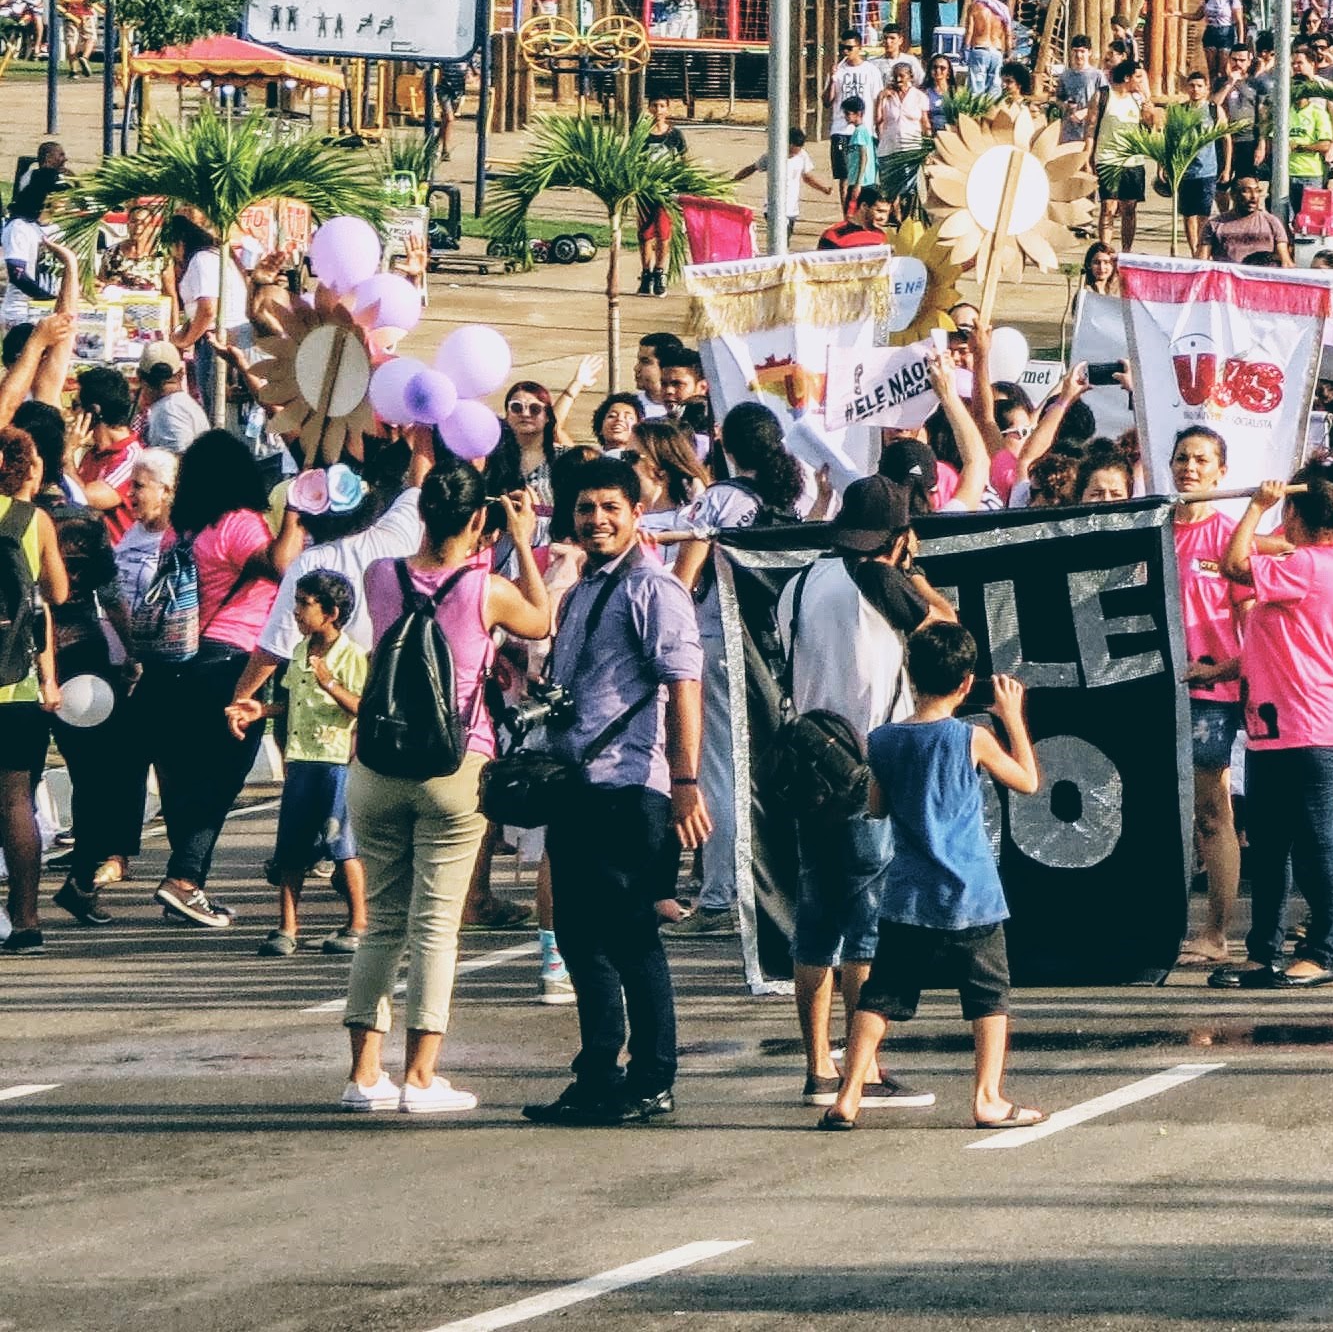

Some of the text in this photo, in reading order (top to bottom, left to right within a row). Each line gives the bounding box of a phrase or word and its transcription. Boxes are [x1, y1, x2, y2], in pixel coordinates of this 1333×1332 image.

[904, 276, 925, 295] NÃ
[1021, 367, 1052, 385] met
[845, 384, 887, 422] #ELE
[940, 561, 1166, 690] LE
